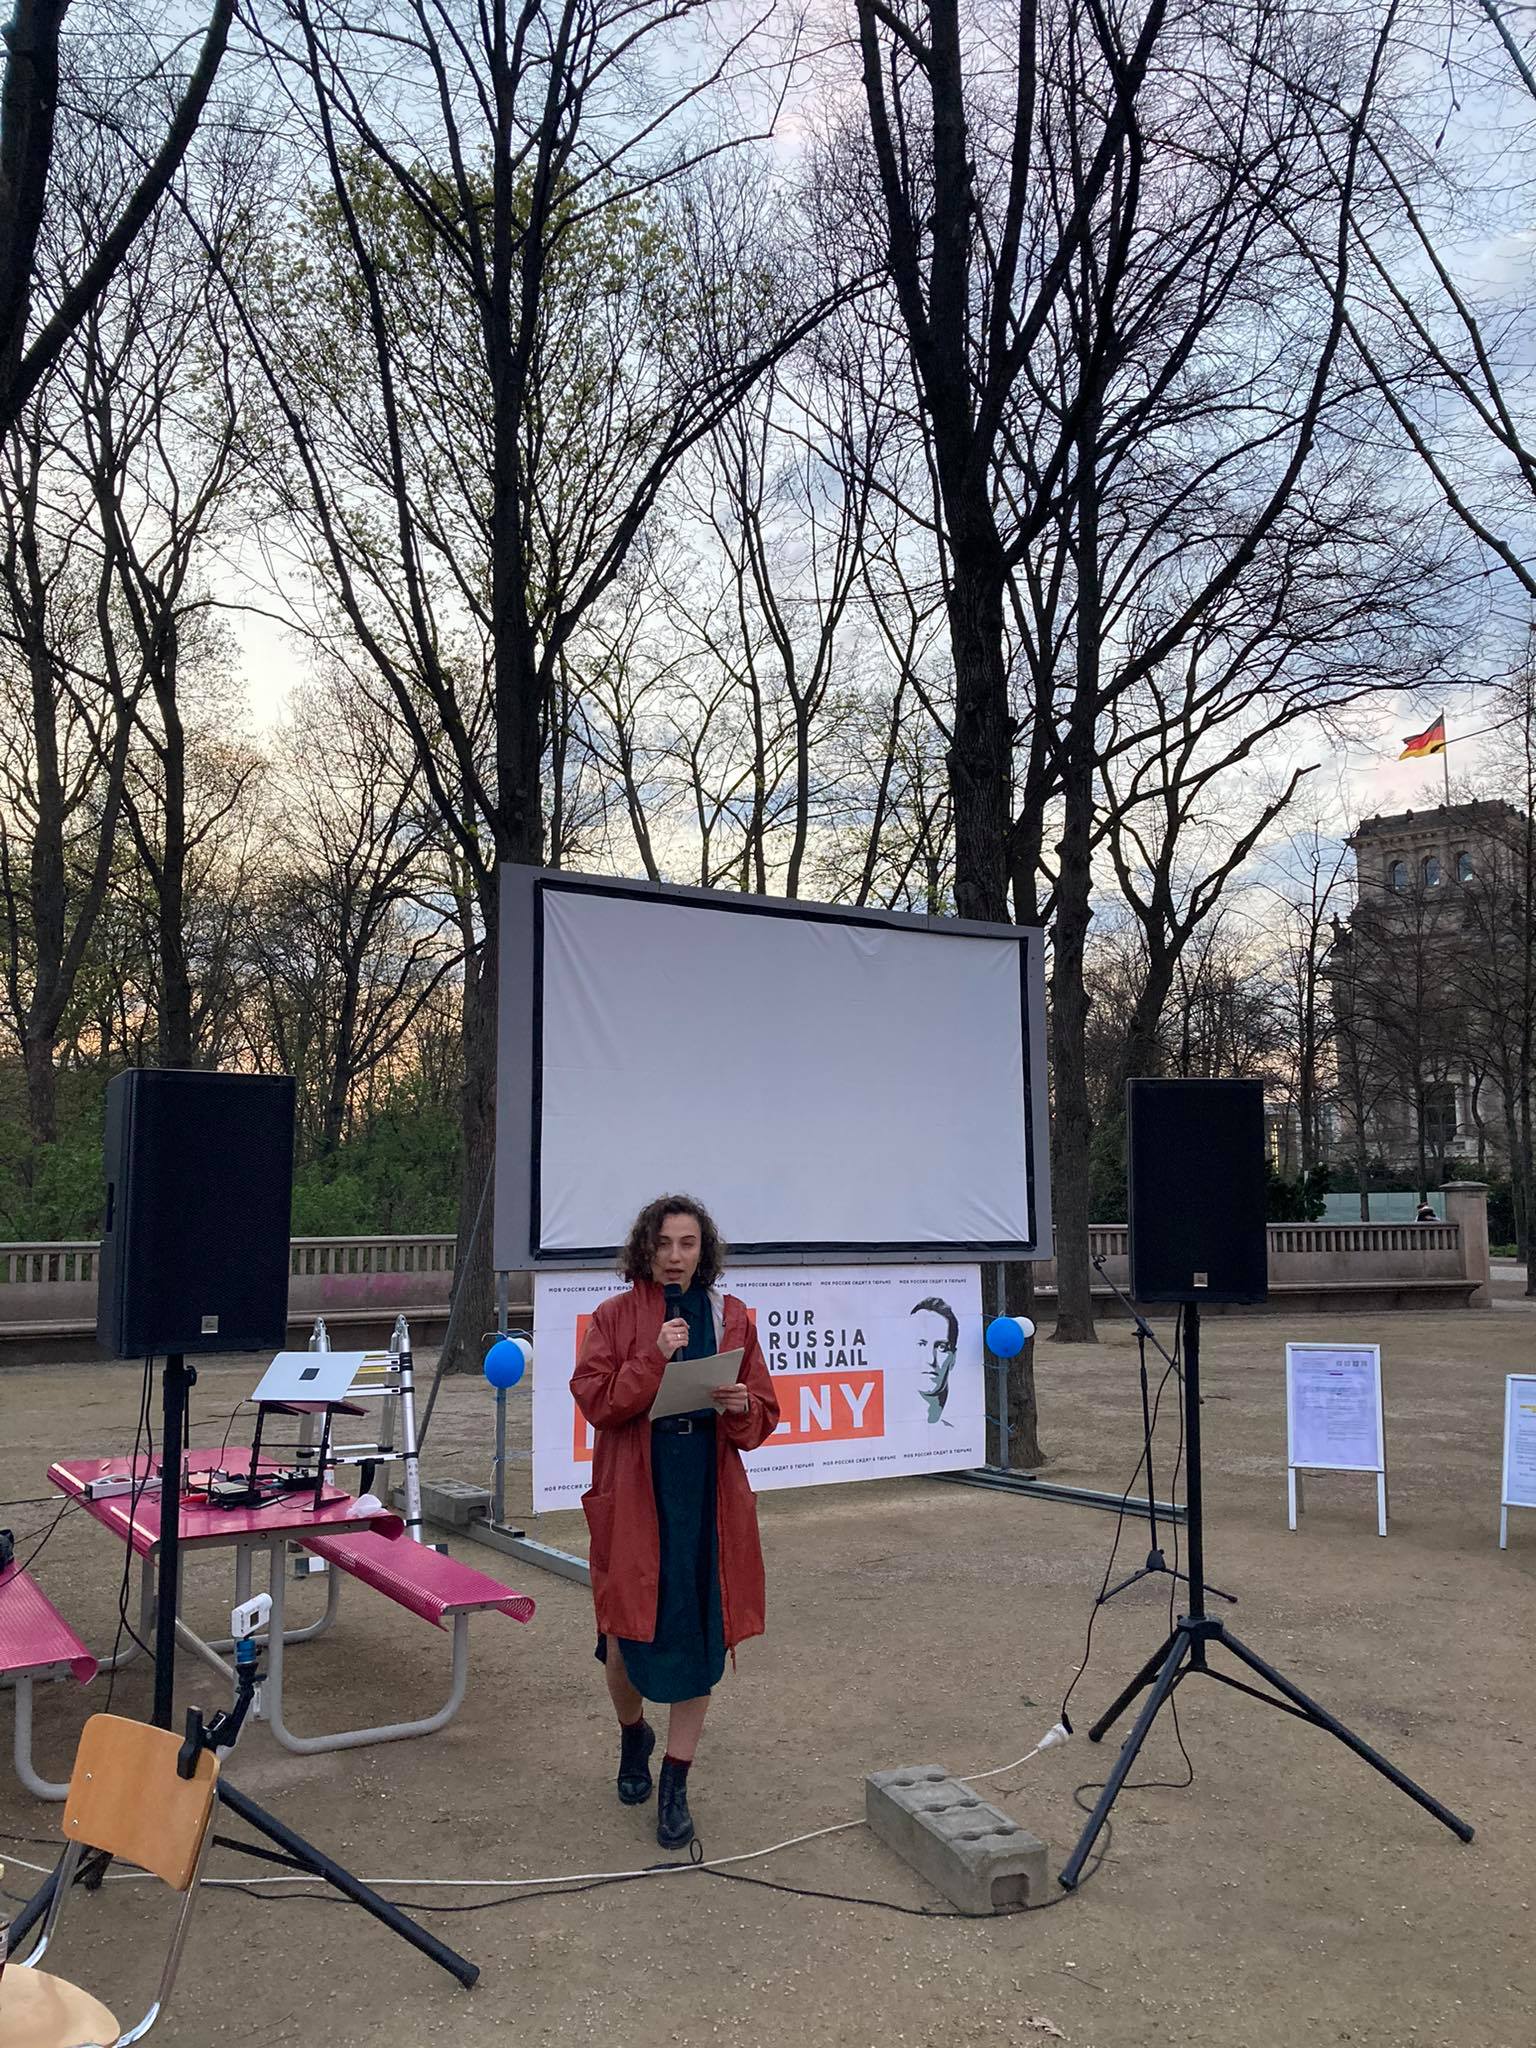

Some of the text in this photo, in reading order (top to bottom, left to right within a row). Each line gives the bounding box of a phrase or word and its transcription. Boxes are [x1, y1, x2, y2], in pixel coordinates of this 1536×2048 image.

[768, 1310, 815, 1327] OUR
[769, 1328, 866, 1350] RUSSIA
[769, 1348, 868, 1371] IS IN JAIL
